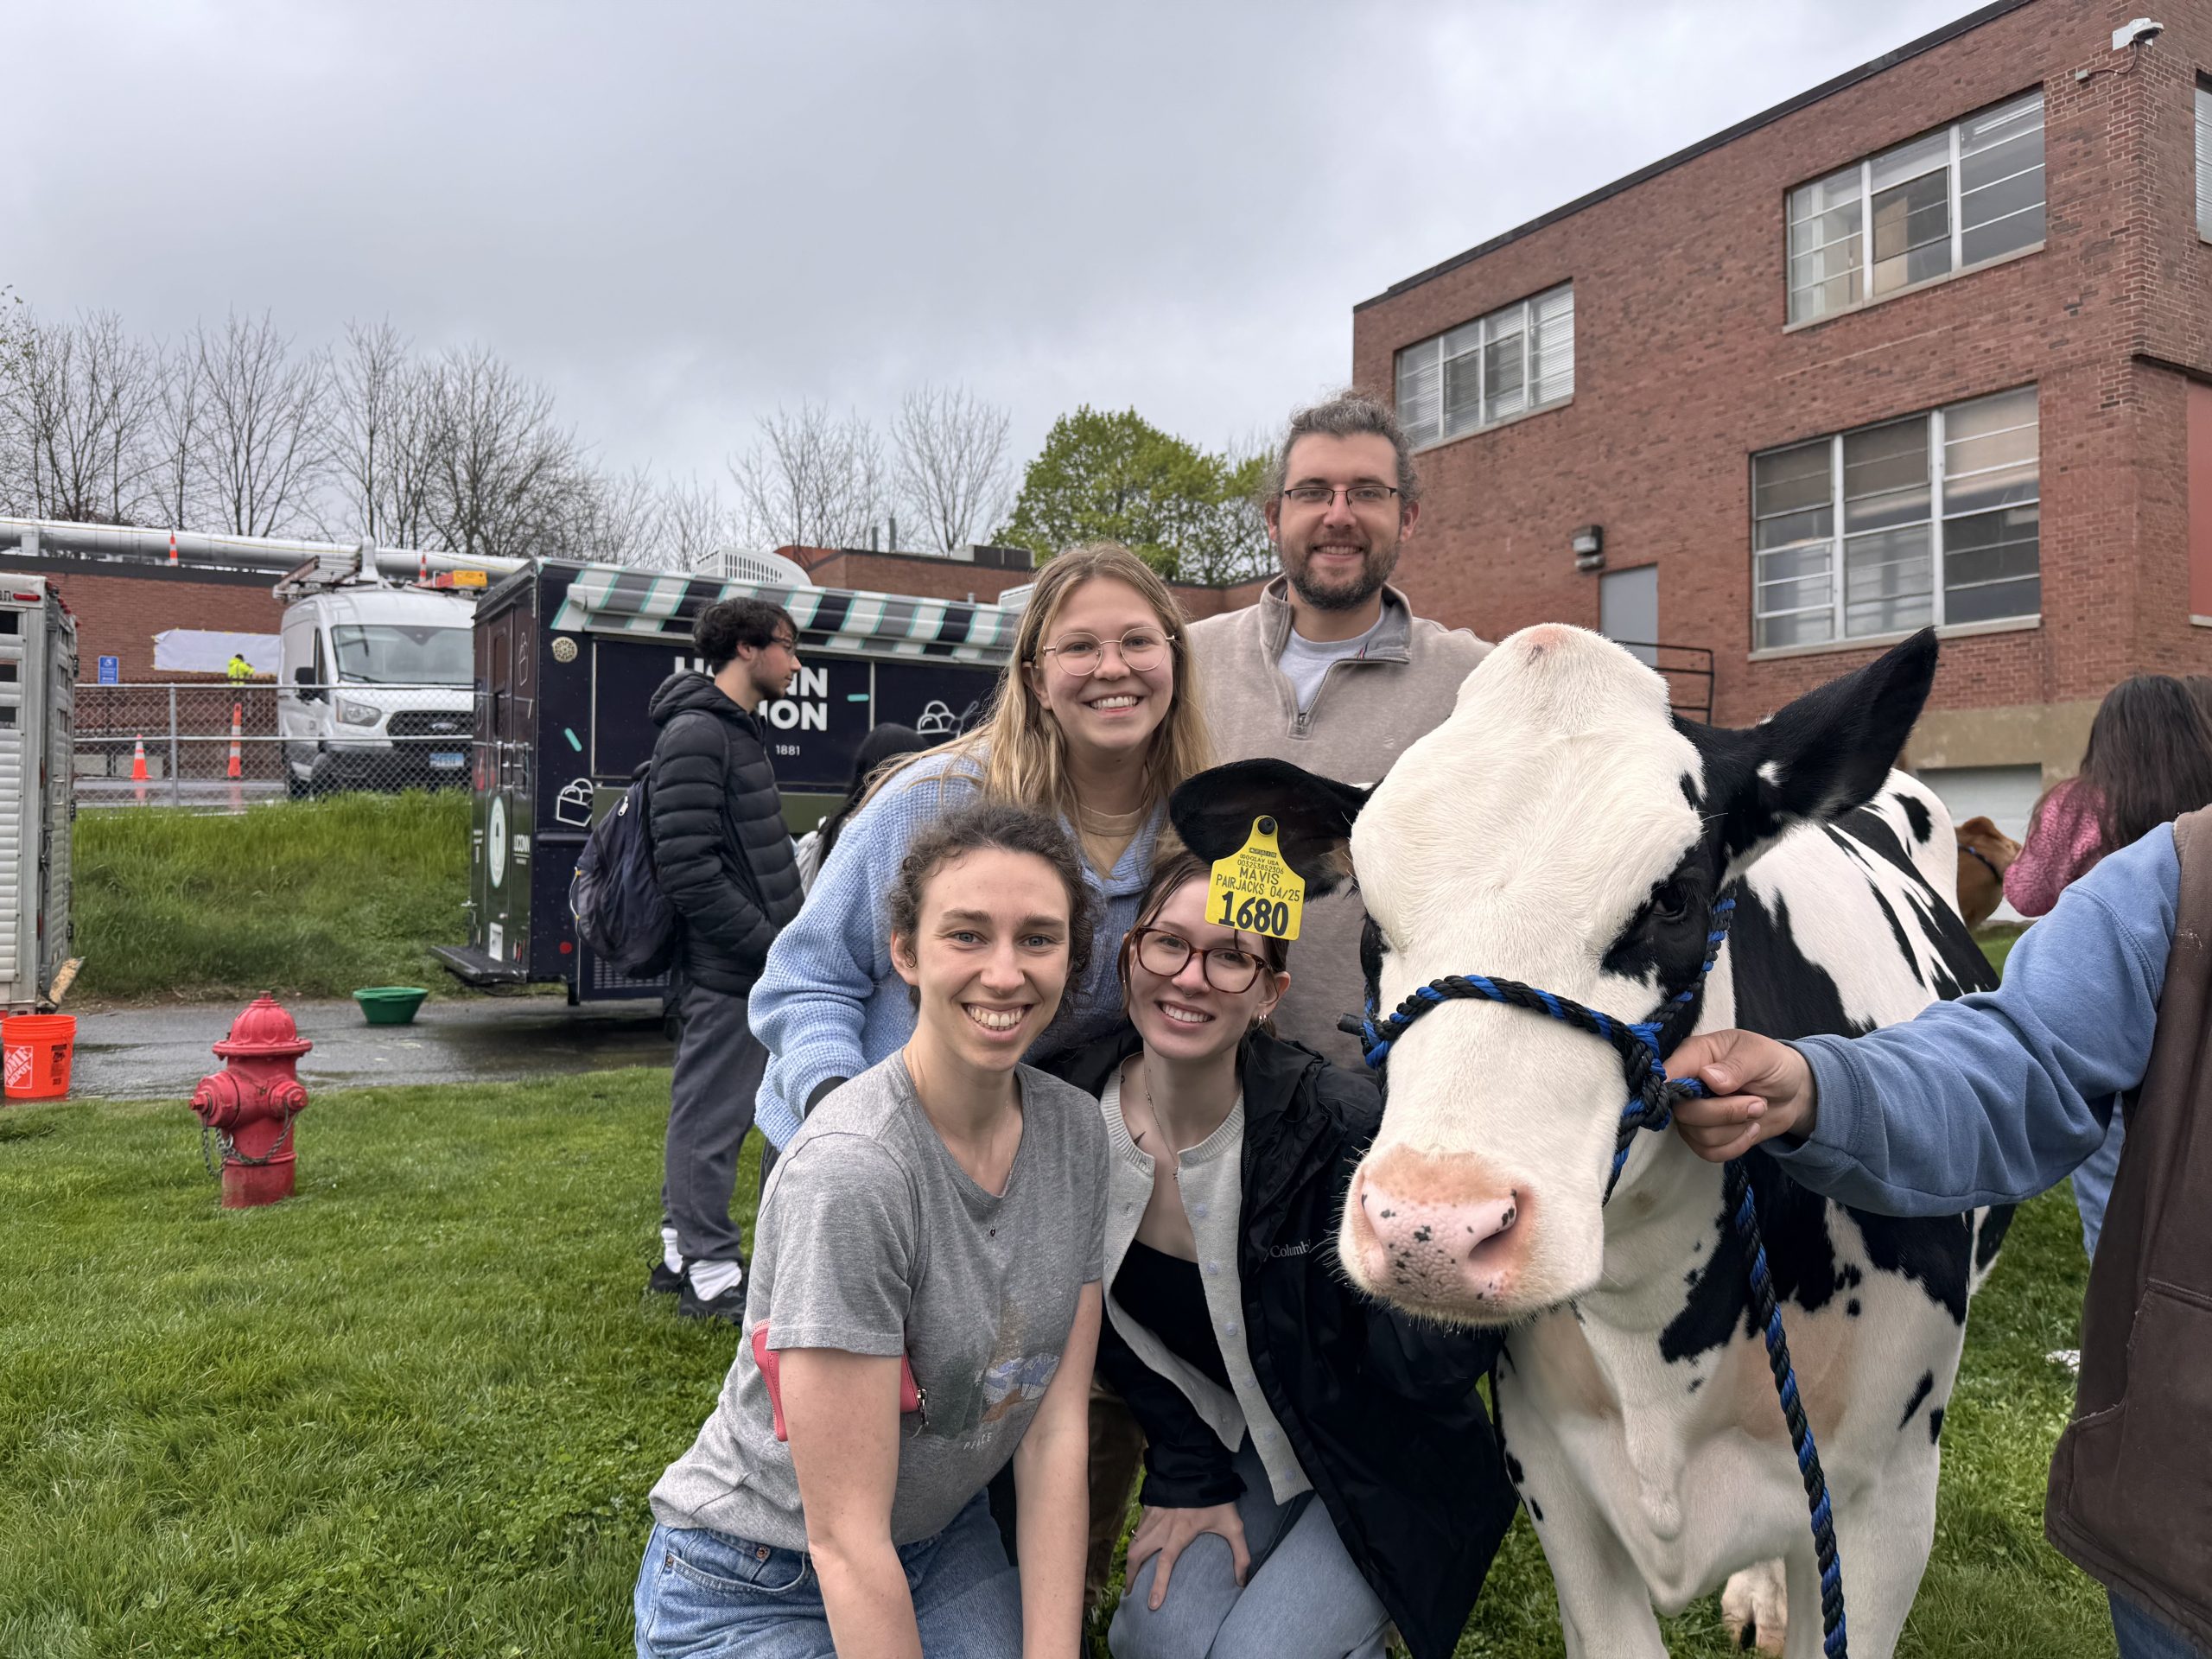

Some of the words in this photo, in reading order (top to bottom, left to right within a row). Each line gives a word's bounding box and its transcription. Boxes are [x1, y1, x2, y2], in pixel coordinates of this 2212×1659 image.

[776, 745, 800, 756] 1881
[513, 835, 531, 853] UCONN
[1239, 867, 1280, 886] MAVIS
[1269, 886, 1300, 902] 04/25
[1218, 890, 1288, 937] 1680
[1270, 1239, 1311, 1258] Columb
